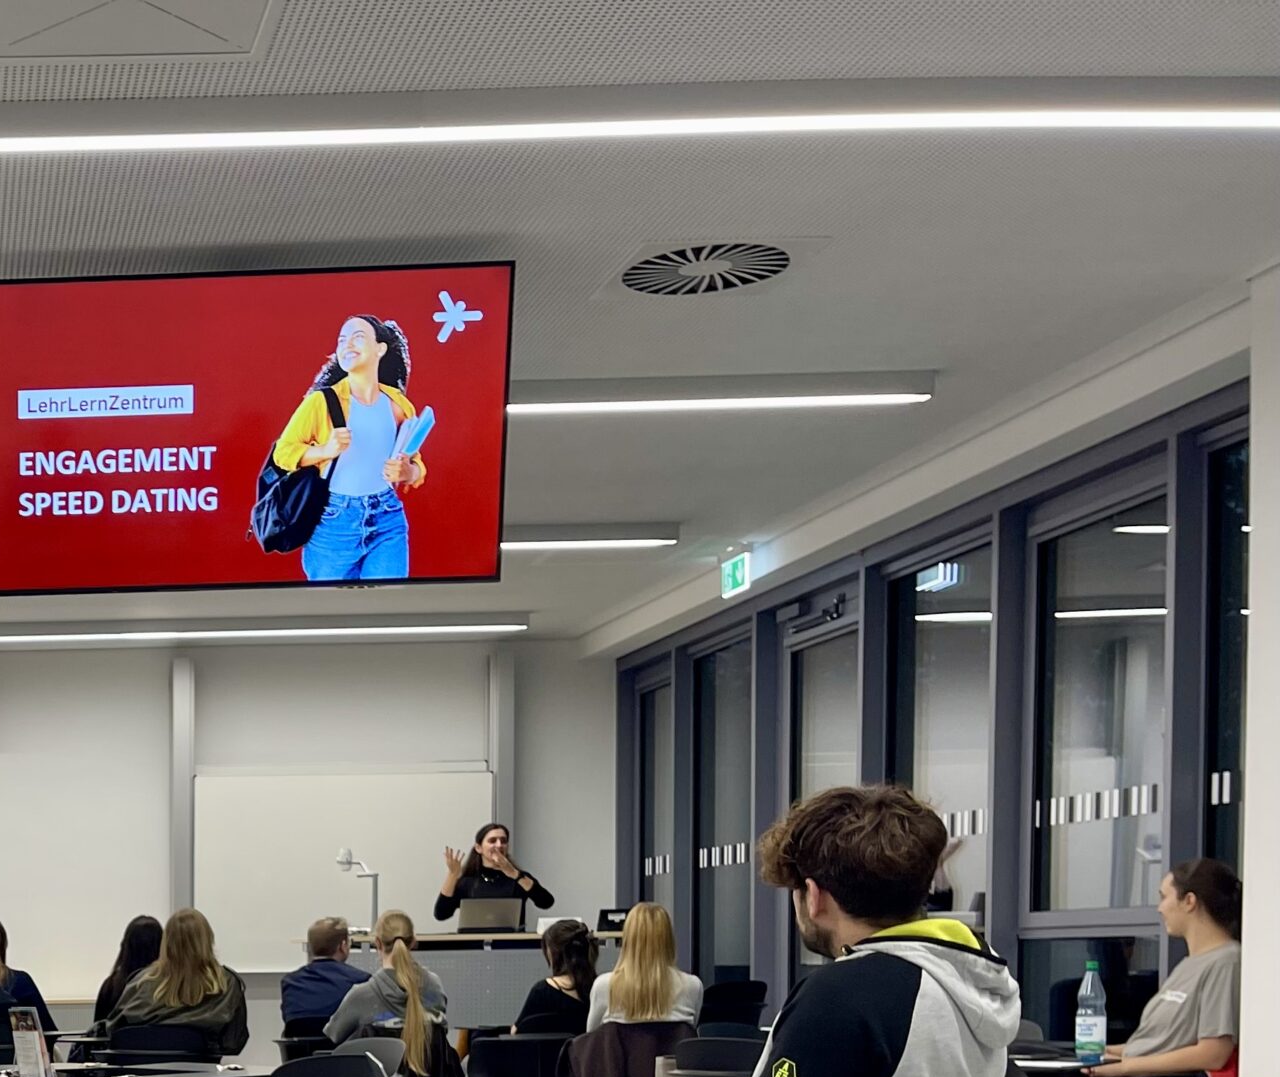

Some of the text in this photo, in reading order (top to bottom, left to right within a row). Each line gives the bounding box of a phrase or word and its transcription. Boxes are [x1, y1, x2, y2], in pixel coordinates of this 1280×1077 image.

[27, 393, 184, 414] LehrLernZentrum
[19, 445, 217, 476] ENGAGEMENT
[18, 487, 218, 517] SPEED DATING
